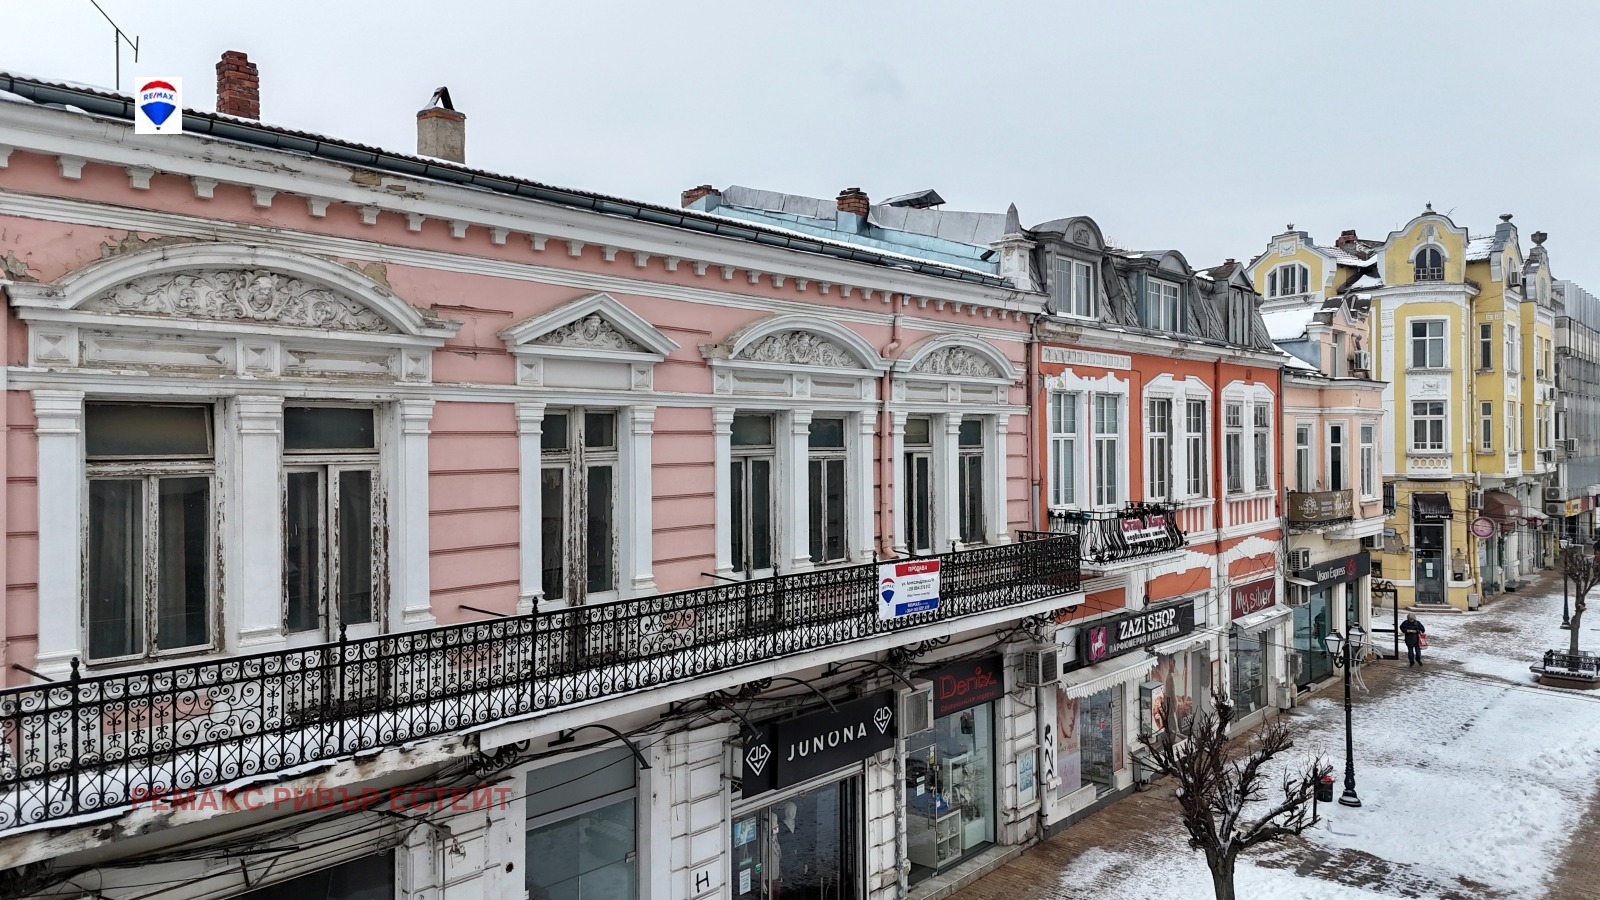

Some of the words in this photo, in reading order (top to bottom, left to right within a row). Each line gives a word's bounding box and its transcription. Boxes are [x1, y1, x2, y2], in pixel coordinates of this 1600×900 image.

[1316, 570, 1330, 582] Vision
[1329, 566, 1346, 580] Express
[1235, 590, 1250, 615] My
[1147, 608, 1176, 632] SHOP
[1109, 636, 1147, 654] ПАРФЮМЕРИЯ
[1147, 633, 1152, 643] И
[1151, 624, 1180, 641] КОЗМЕТИКА
[787, 722, 867, 762] JUNONA
